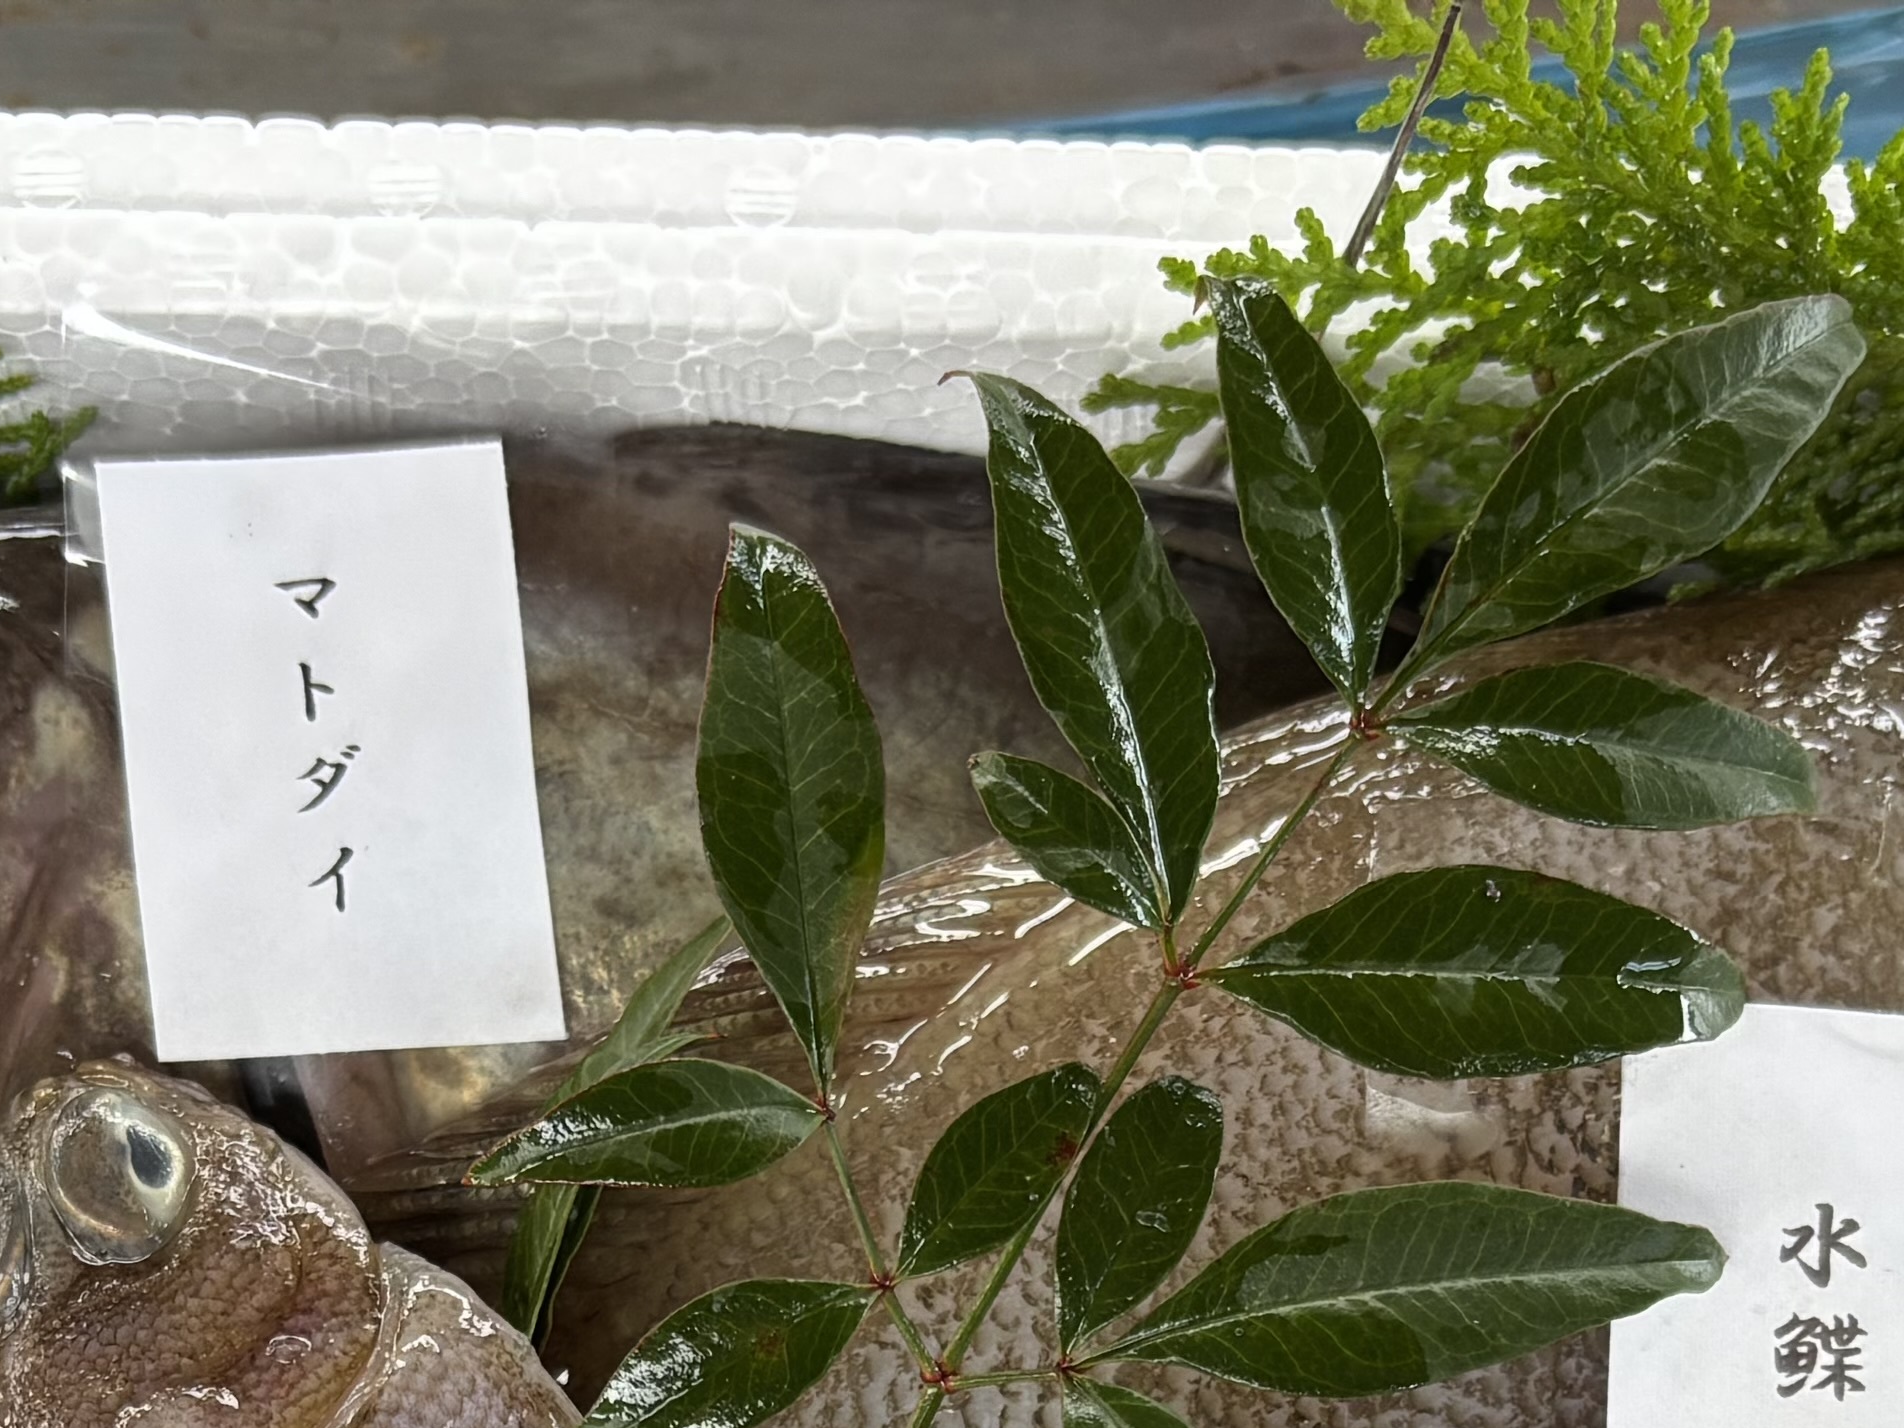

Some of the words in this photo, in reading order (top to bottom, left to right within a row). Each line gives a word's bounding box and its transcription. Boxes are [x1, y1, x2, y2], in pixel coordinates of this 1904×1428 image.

[274, 577, 362, 913] マトダイ
[1774, 1203, 1867, 1402] 水鰈
